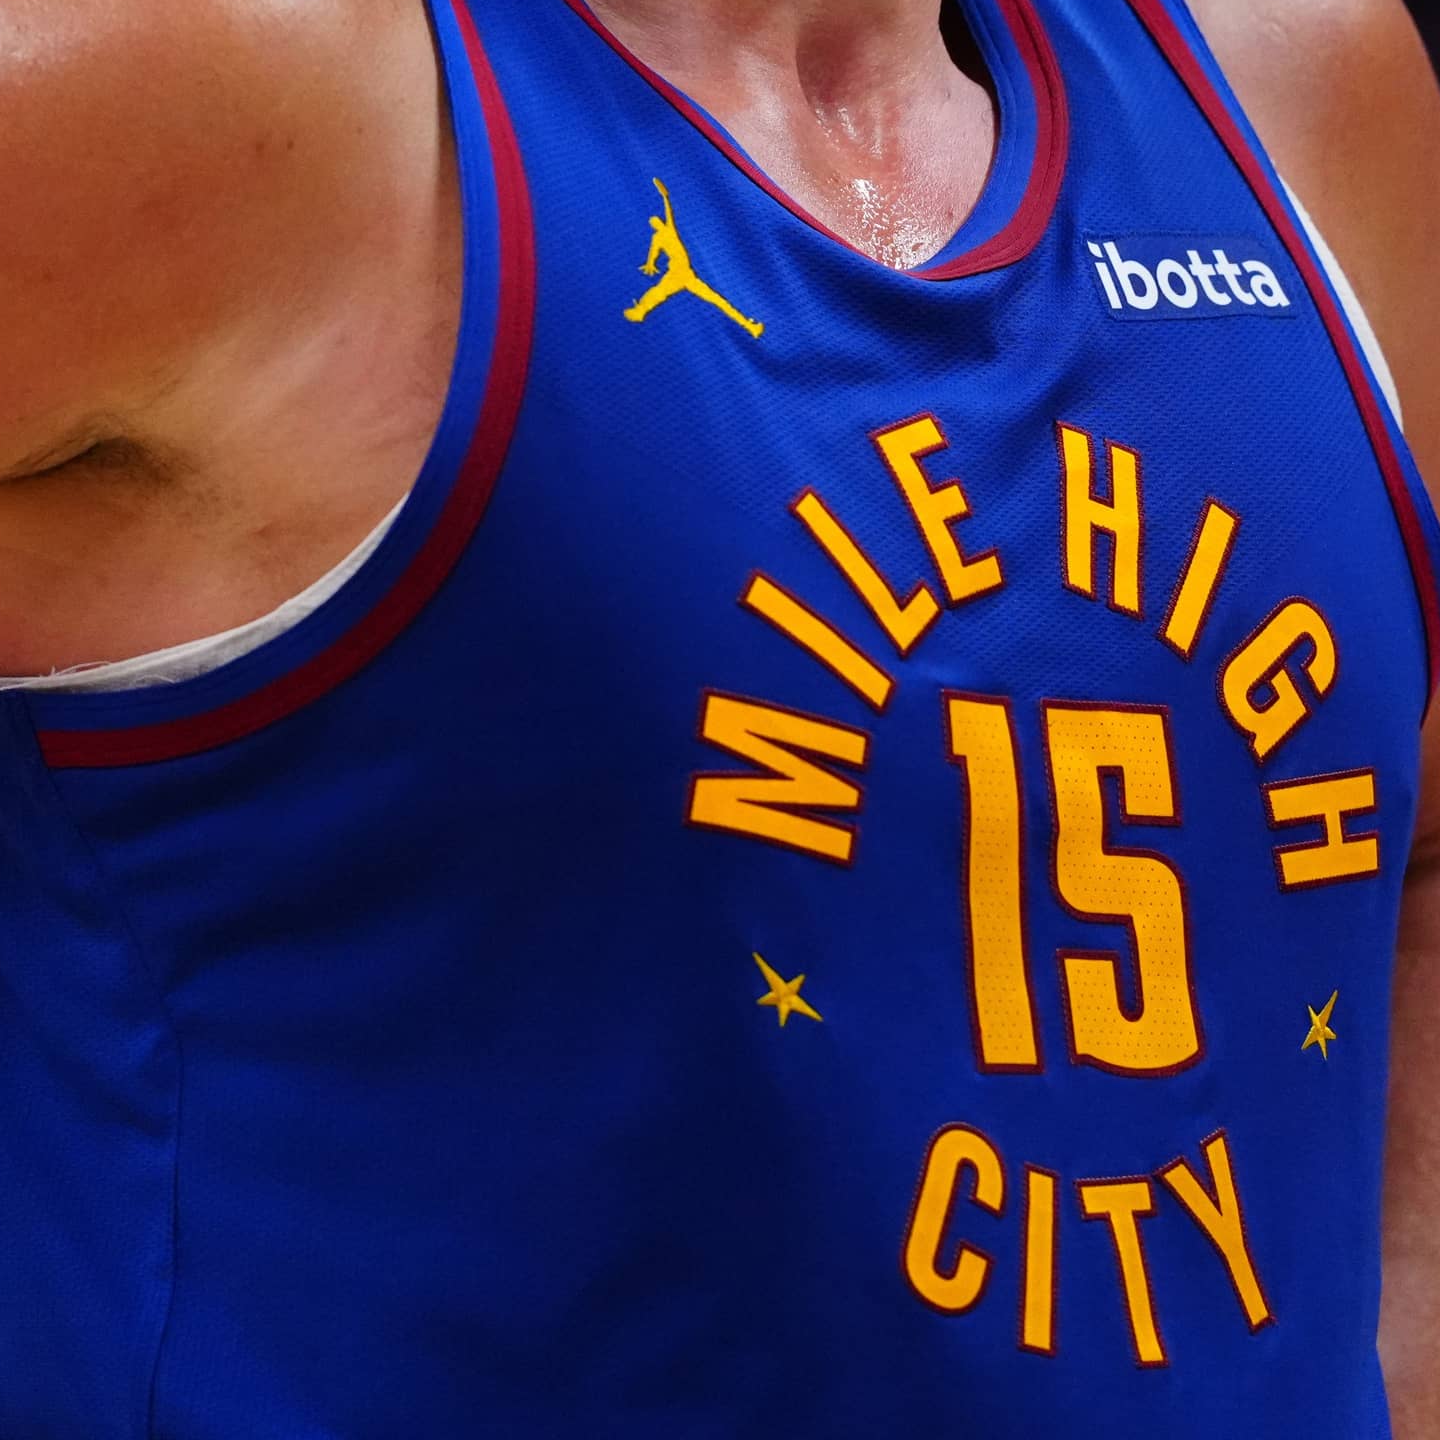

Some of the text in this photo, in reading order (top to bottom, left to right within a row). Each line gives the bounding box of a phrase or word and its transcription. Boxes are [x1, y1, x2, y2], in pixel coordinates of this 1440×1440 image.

[1086, 240, 1292, 310] ibotta
[687, 413, 1381, 888] MILE HIGH
[942, 692, 1205, 1076] 15
[902, 1123, 1275, 1367] CITY
